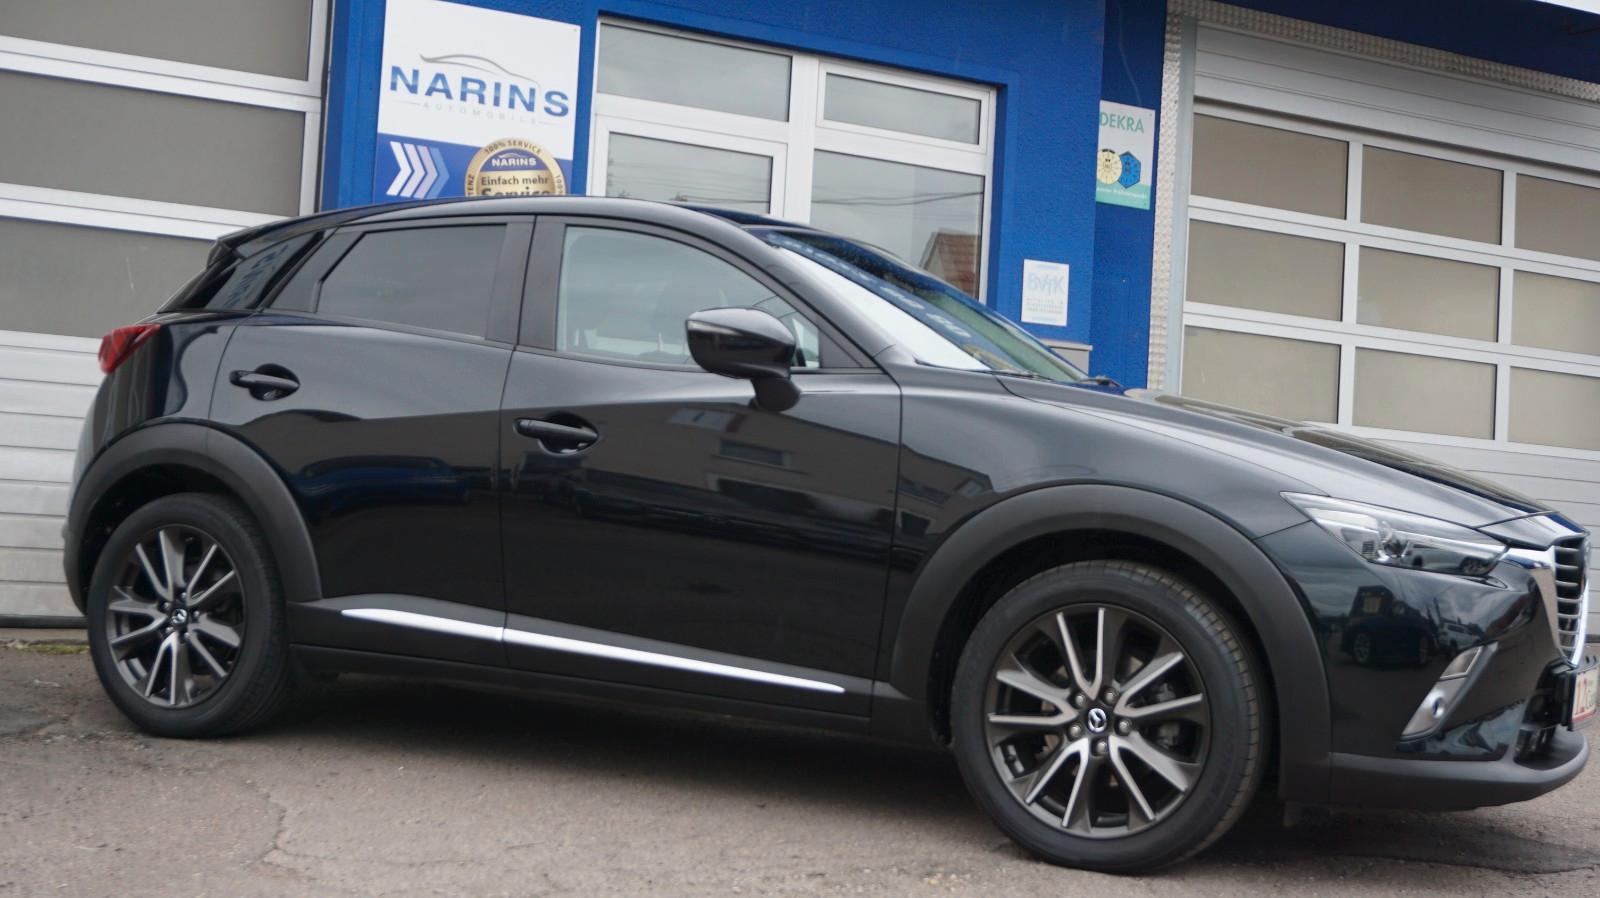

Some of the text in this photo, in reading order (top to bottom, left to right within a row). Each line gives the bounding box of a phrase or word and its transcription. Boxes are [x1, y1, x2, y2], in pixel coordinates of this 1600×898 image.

[389, 65, 569, 118] NARINS
[1099, 111, 1145, 133] DEKRA
[507, 140, 542, 154] SERVICE
[491, 157, 537, 167] NARINS
[481, 175, 549, 186] Einfach mehr
